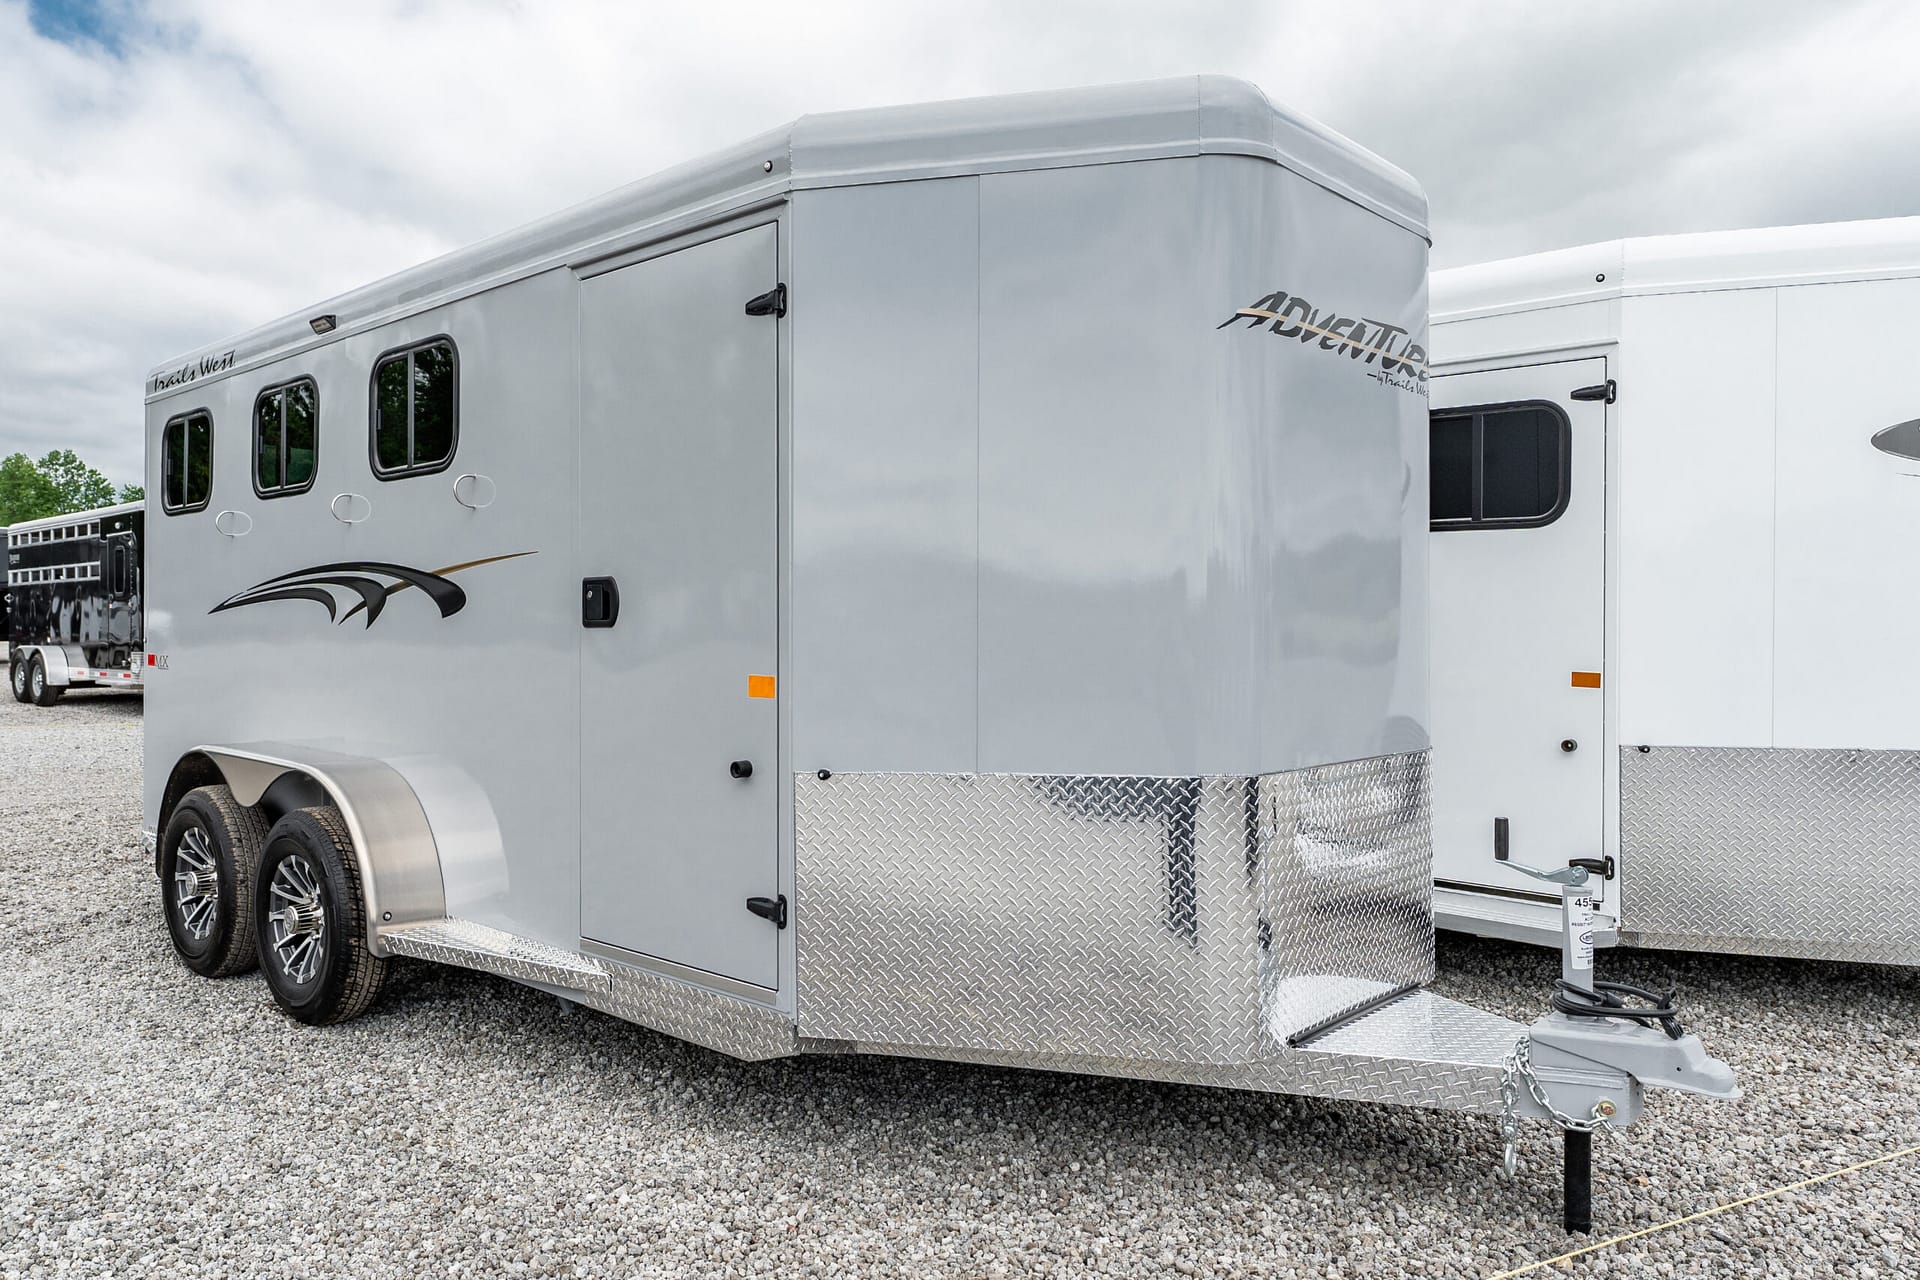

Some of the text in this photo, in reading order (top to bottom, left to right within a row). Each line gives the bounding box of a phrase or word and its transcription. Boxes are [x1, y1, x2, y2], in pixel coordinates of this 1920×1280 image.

[151, 349, 235, 392] Trails West
[1382, 370, 1414, 392] Trails
